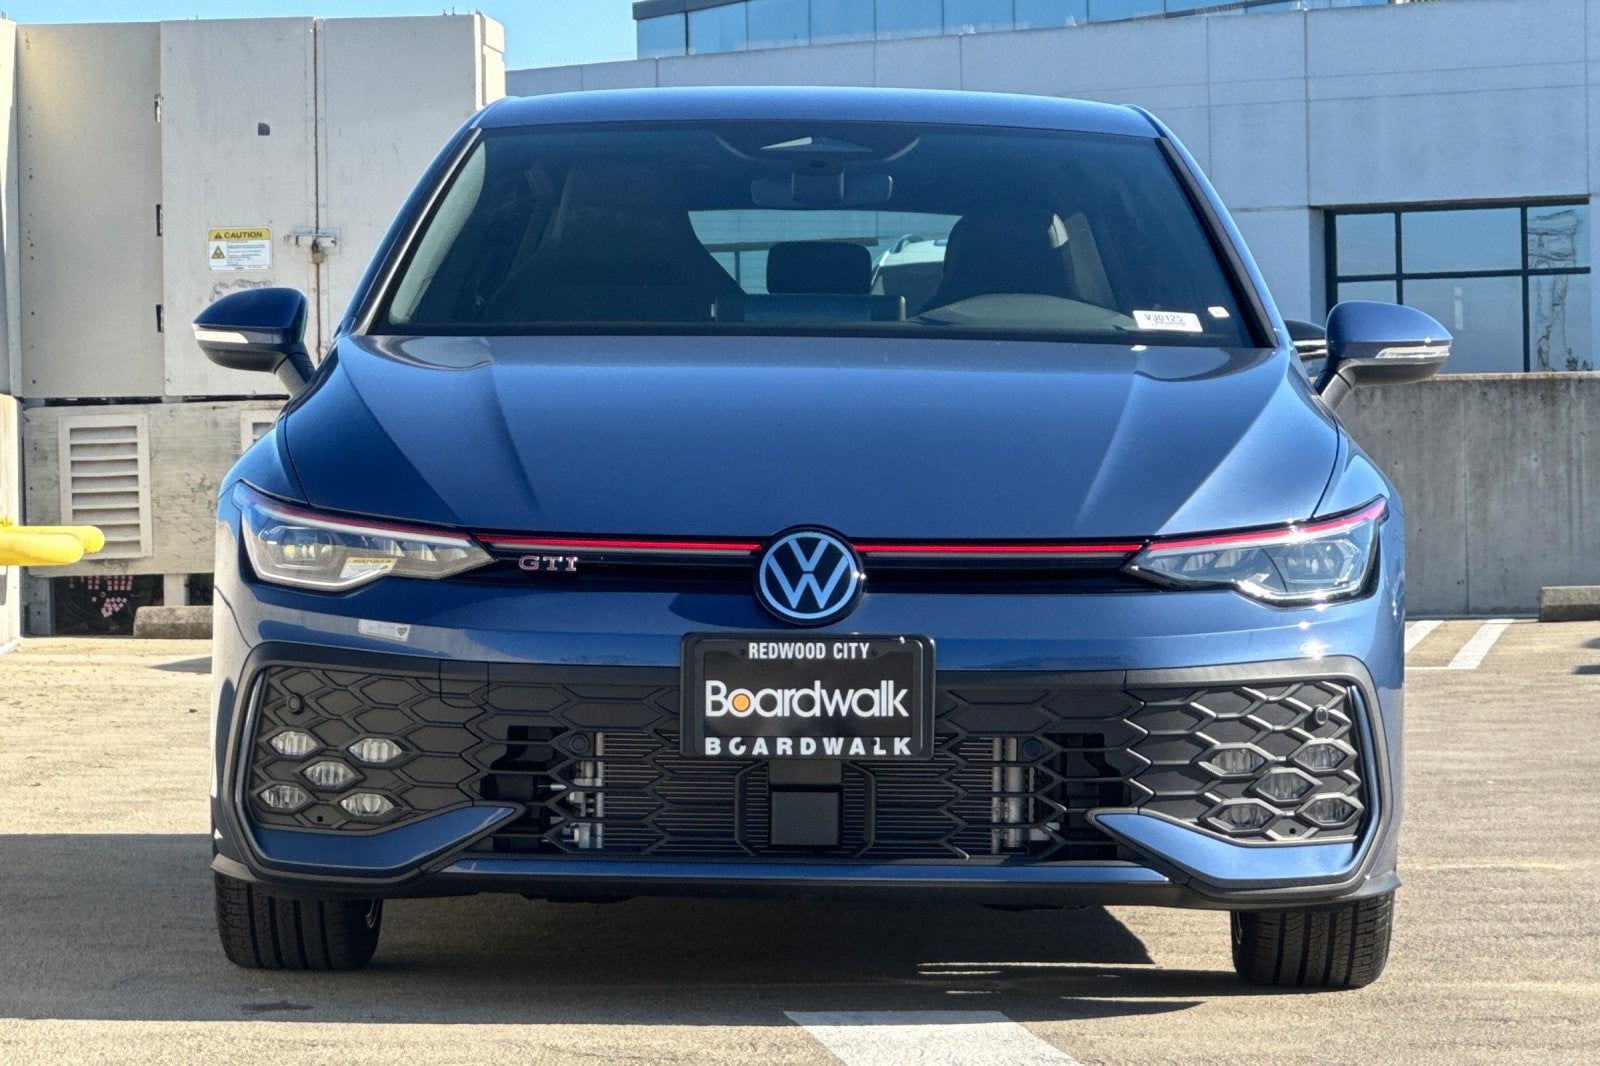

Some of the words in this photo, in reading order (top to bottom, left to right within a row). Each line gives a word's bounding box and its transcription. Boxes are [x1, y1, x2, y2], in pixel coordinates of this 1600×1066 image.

[223, 231, 263, 239] CAUTION
[518, 555, 578, 571] GTI
[748, 642, 826, 660] REDWOOD
[833, 642, 870, 660] CITY
[705, 680, 909, 718] Boardwalk
[705, 737, 912, 755] BOARDWALK
